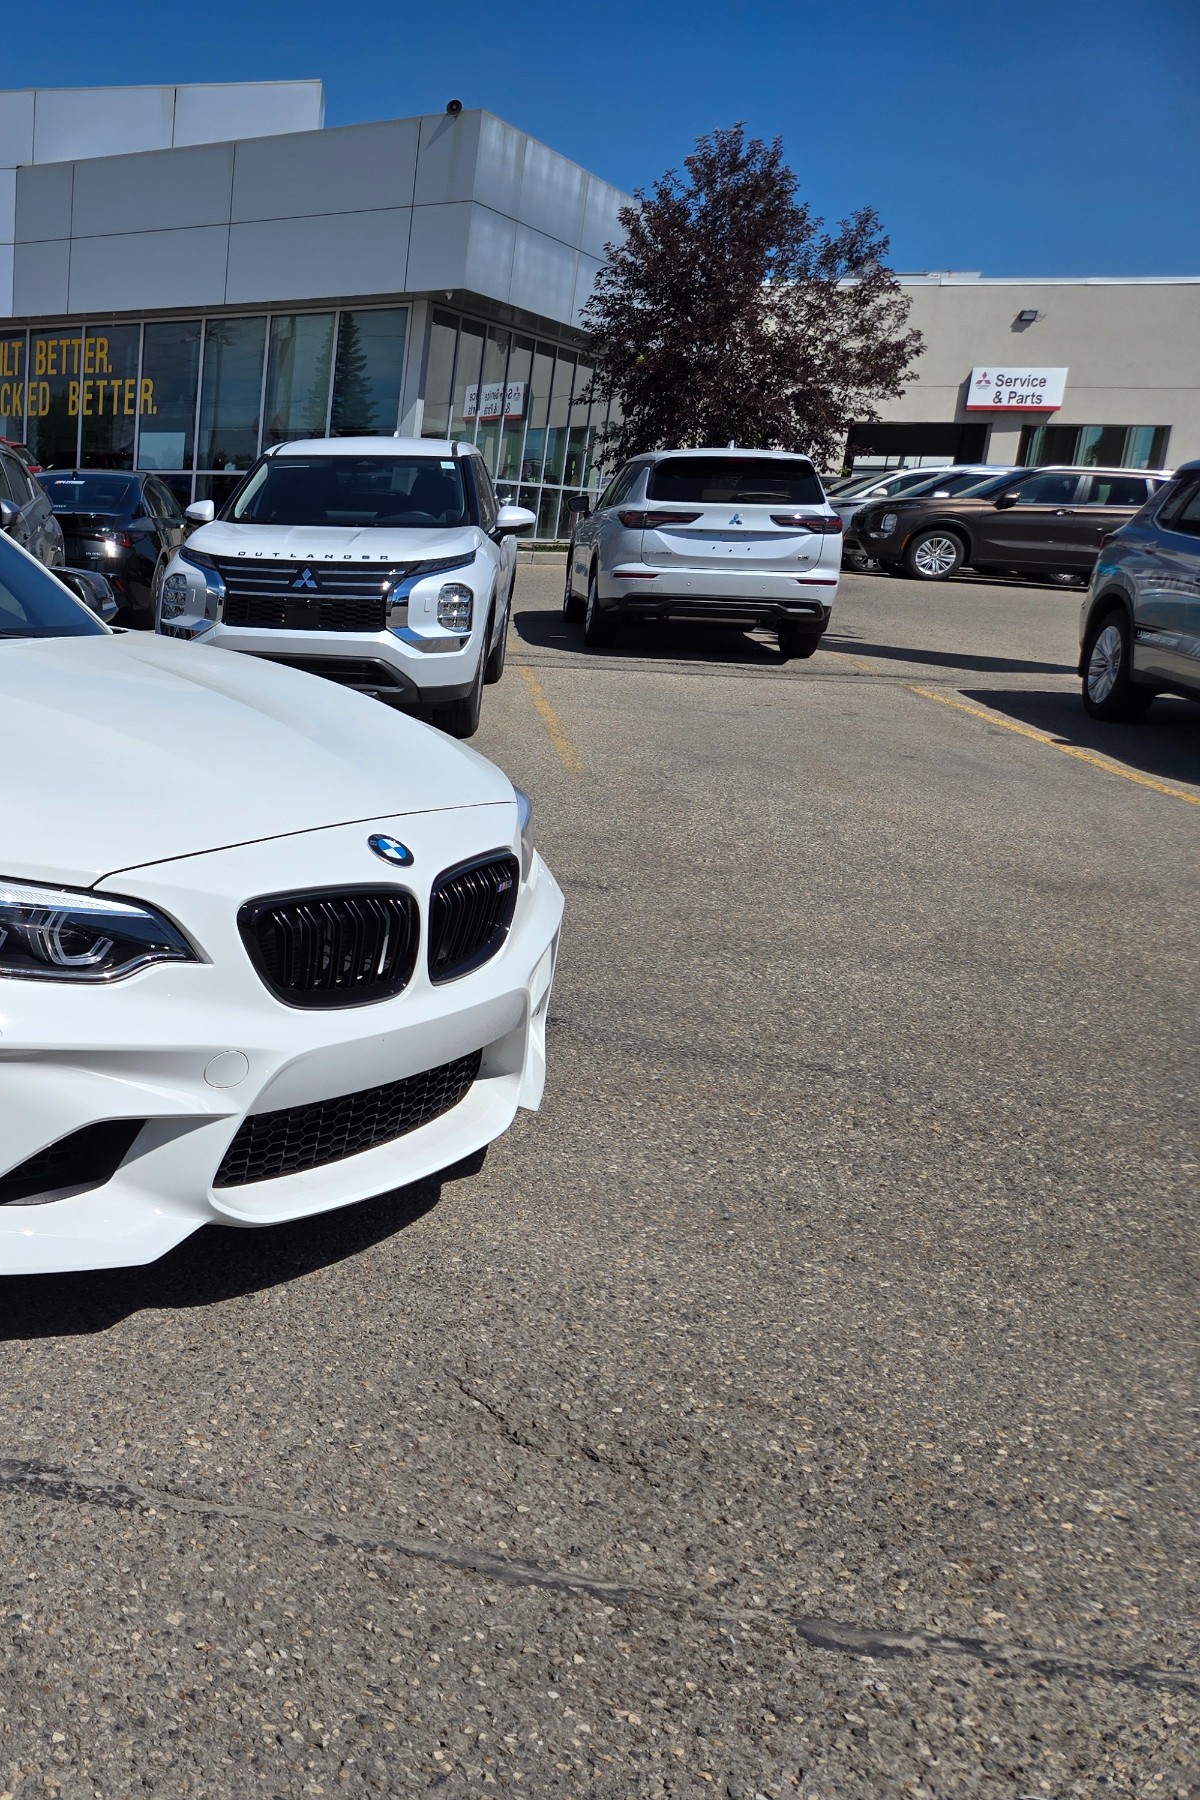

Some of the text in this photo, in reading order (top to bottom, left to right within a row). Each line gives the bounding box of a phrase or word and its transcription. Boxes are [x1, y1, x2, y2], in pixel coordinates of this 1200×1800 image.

[35, 337, 113, 375] BETTER.
[994, 373, 1047, 388] Service
[68, 378, 158, 416] BETTER.
[992, 390, 1043, 405] & Parts
[237, 551, 389, 561] OUTLANDER
